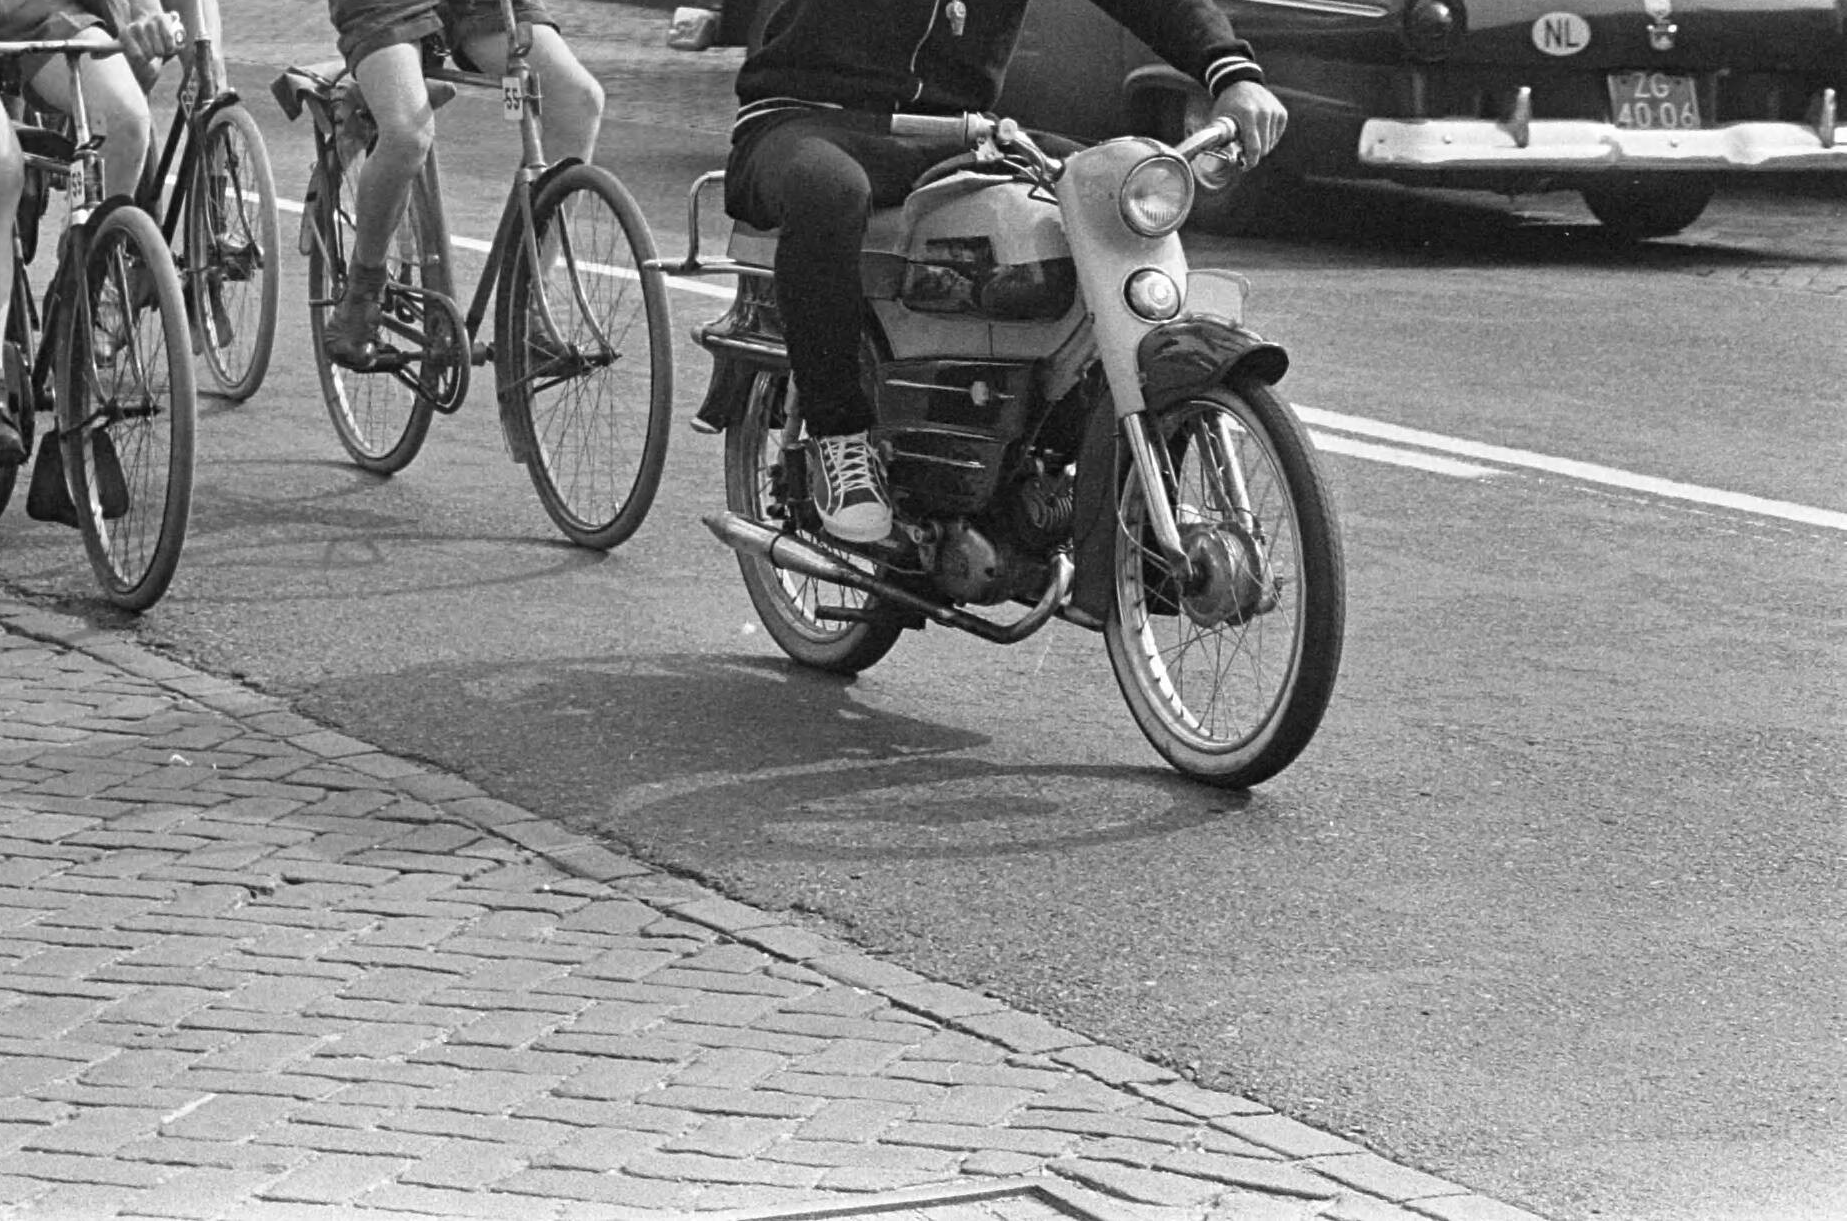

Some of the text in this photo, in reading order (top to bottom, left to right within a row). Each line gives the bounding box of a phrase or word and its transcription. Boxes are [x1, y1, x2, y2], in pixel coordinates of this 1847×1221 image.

[1544, 19, 1579, 49] NL
[1632, 73, 1670, 98] ZG
[504, 87, 520, 111] 55
